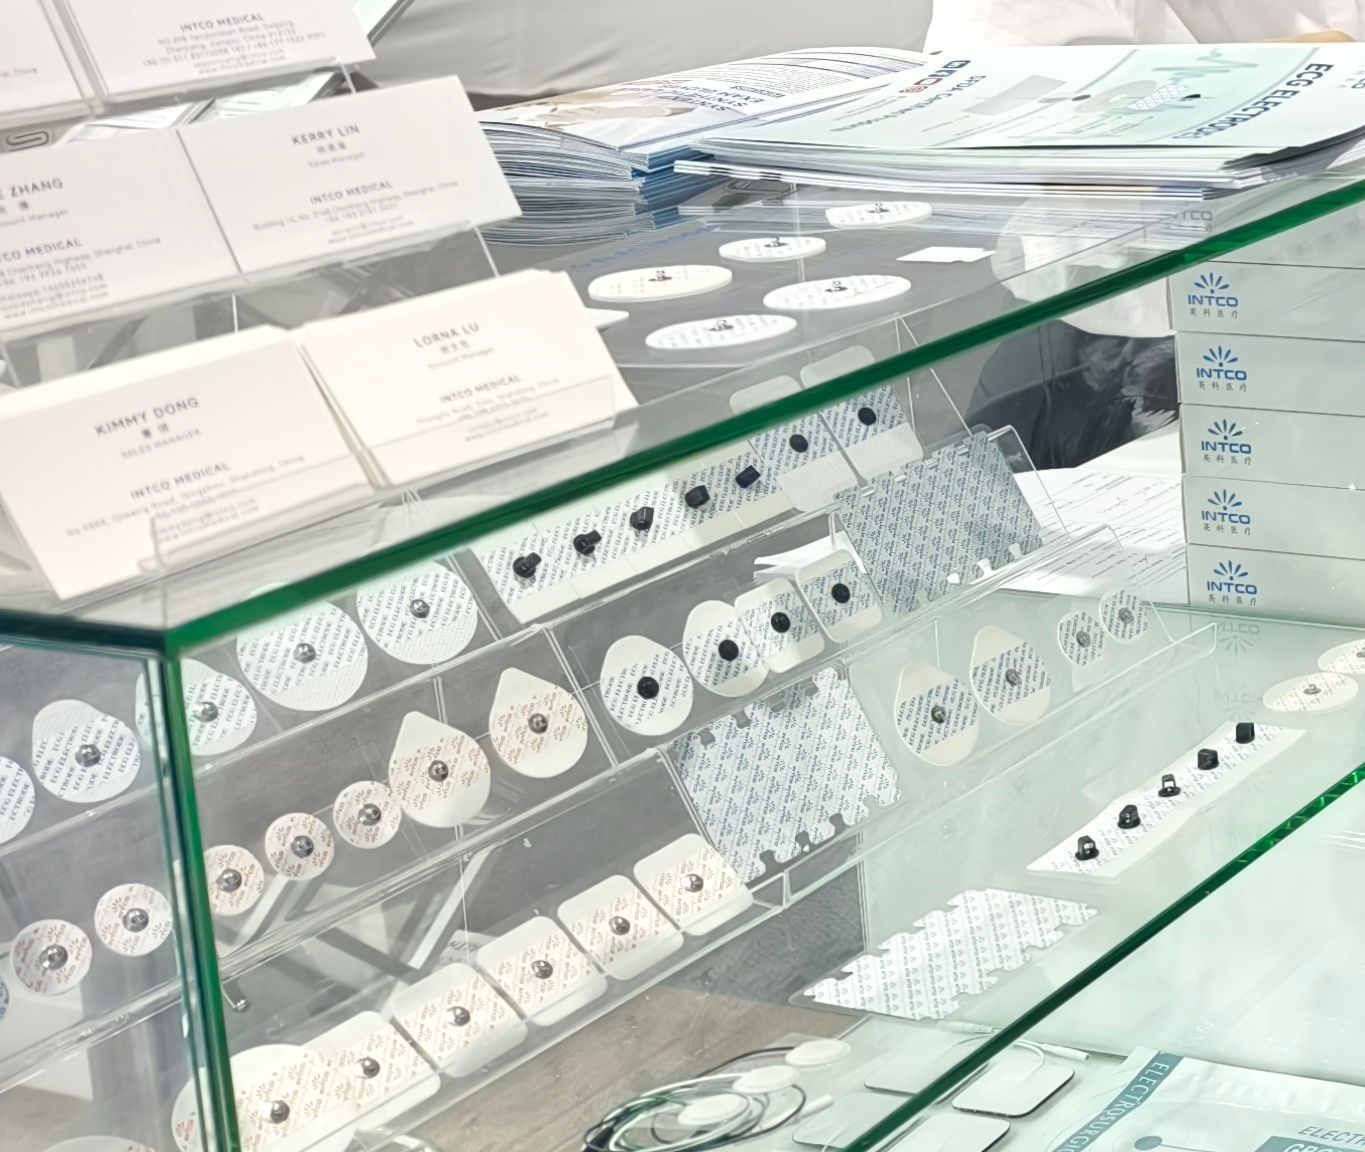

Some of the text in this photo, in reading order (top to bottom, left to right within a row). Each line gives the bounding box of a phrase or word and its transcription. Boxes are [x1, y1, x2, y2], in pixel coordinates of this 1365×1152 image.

[180, 13, 264, 33] INTCO MEDICAL
[1286, 63, 1334, 87] ECG
[291, 125, 360, 146] KERRY LIN
[10, 178, 64, 198] ZHANG
[310, 180, 393, 205] INTCO MEDICAL
[26, 238, 82, 259] MEDICAL
[1187, 294, 1239, 308] INTCO
[413, 327, 459, 348] LORNA
[461, 321, 480, 336] LU
[475, 374, 521, 394] MEDICAL
[1196, 367, 1247, 382] INTCO
[95, 412, 147, 436] KIMMY
[153, 397, 199, 419] DONG
[1201, 440, 1252, 455] INTCO
[130, 461, 231, 500] INTCO MEDICAL
[1201, 510, 1251, 525] INTCO
[1206, 581, 1258, 596] INTCO
